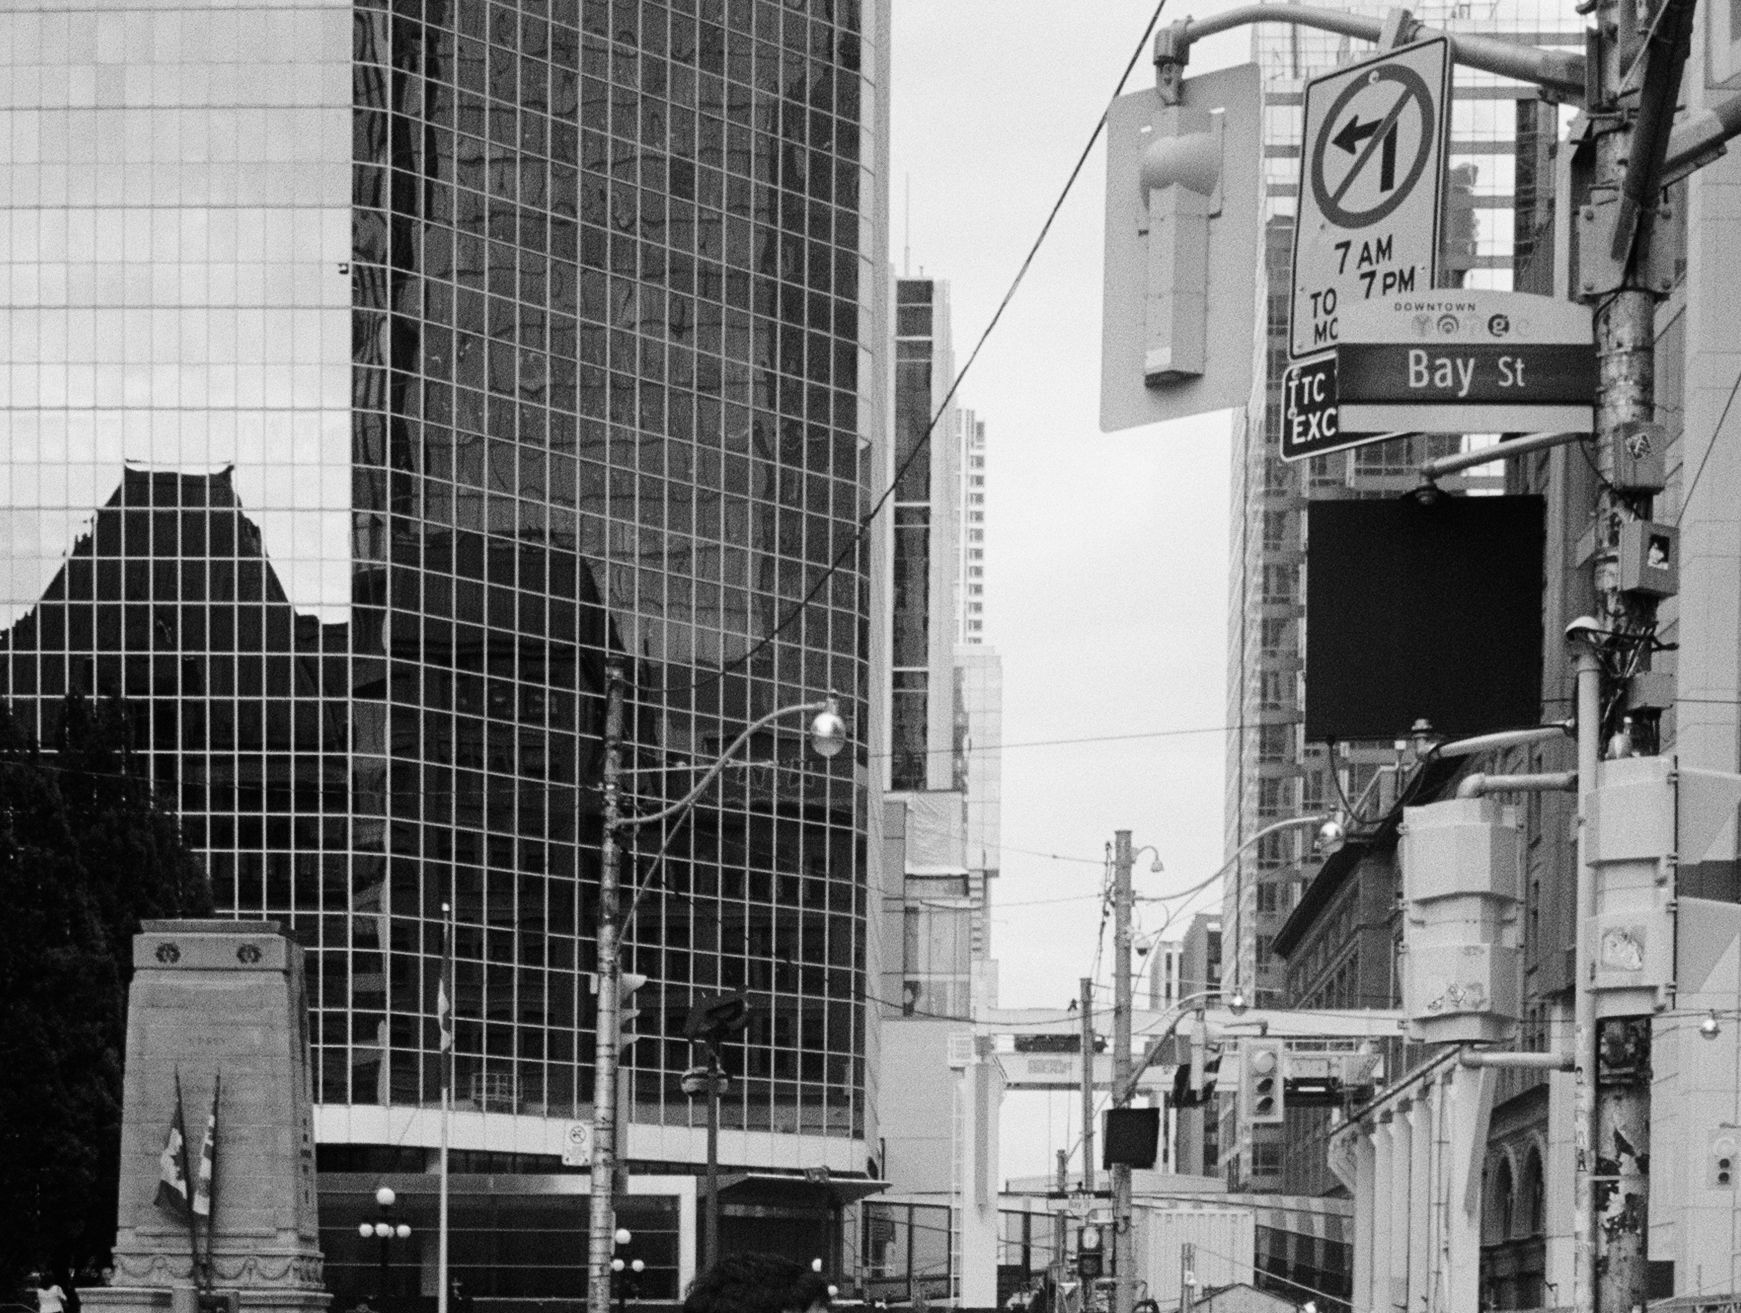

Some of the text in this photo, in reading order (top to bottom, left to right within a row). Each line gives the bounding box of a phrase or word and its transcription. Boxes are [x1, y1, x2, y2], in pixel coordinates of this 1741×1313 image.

[1335, 234, 1393, 275] 7 AM
[1310, 266, 1415, 319] TO 7 PM
[1394, 303, 1475, 311] DOWNTOWN
[1289, 372, 1326, 406] TTC
[1408, 349, 1525, 397] Bay St
